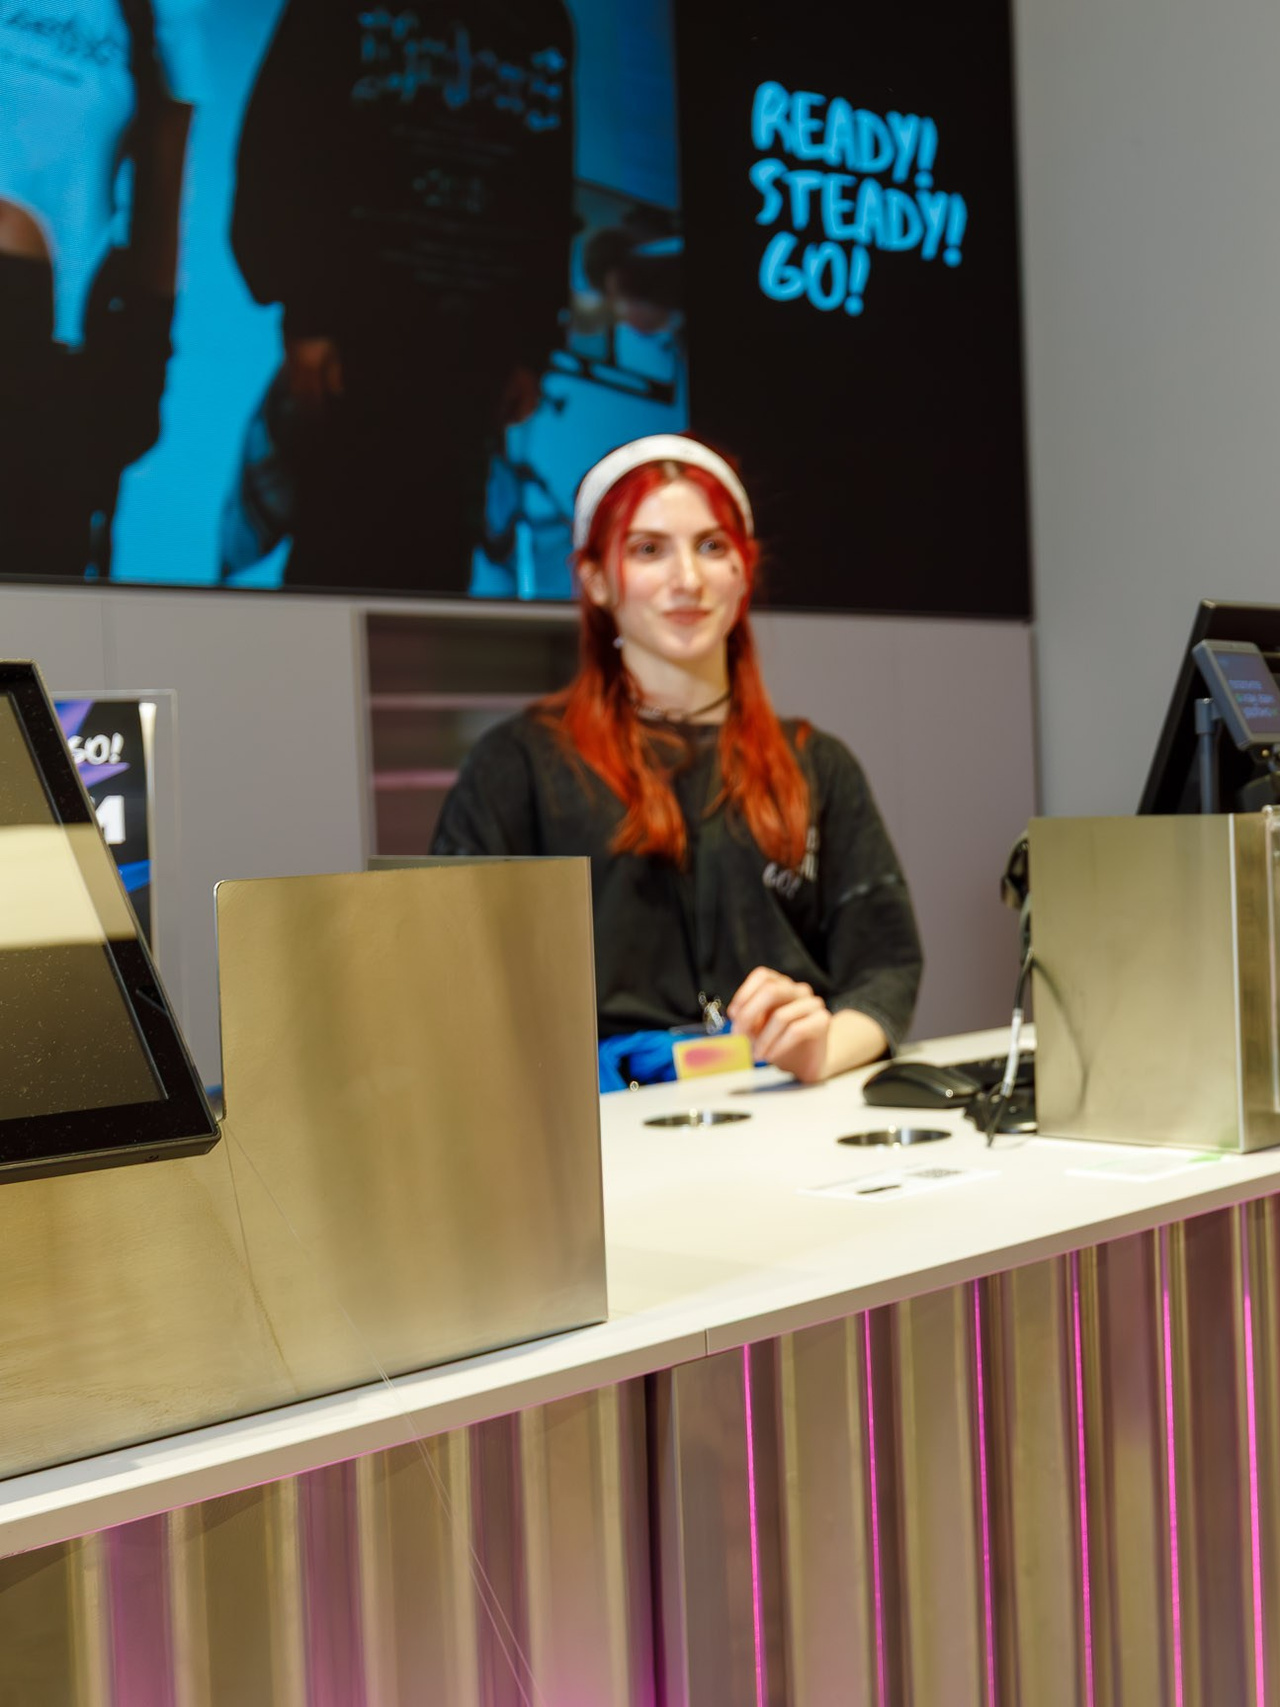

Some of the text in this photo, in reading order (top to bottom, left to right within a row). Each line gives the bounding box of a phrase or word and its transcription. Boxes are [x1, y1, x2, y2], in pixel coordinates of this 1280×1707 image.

[752, 81, 938, 188] READY!
[750, 158, 967, 267] STEADY!
[759, 231, 870, 316] GO!
